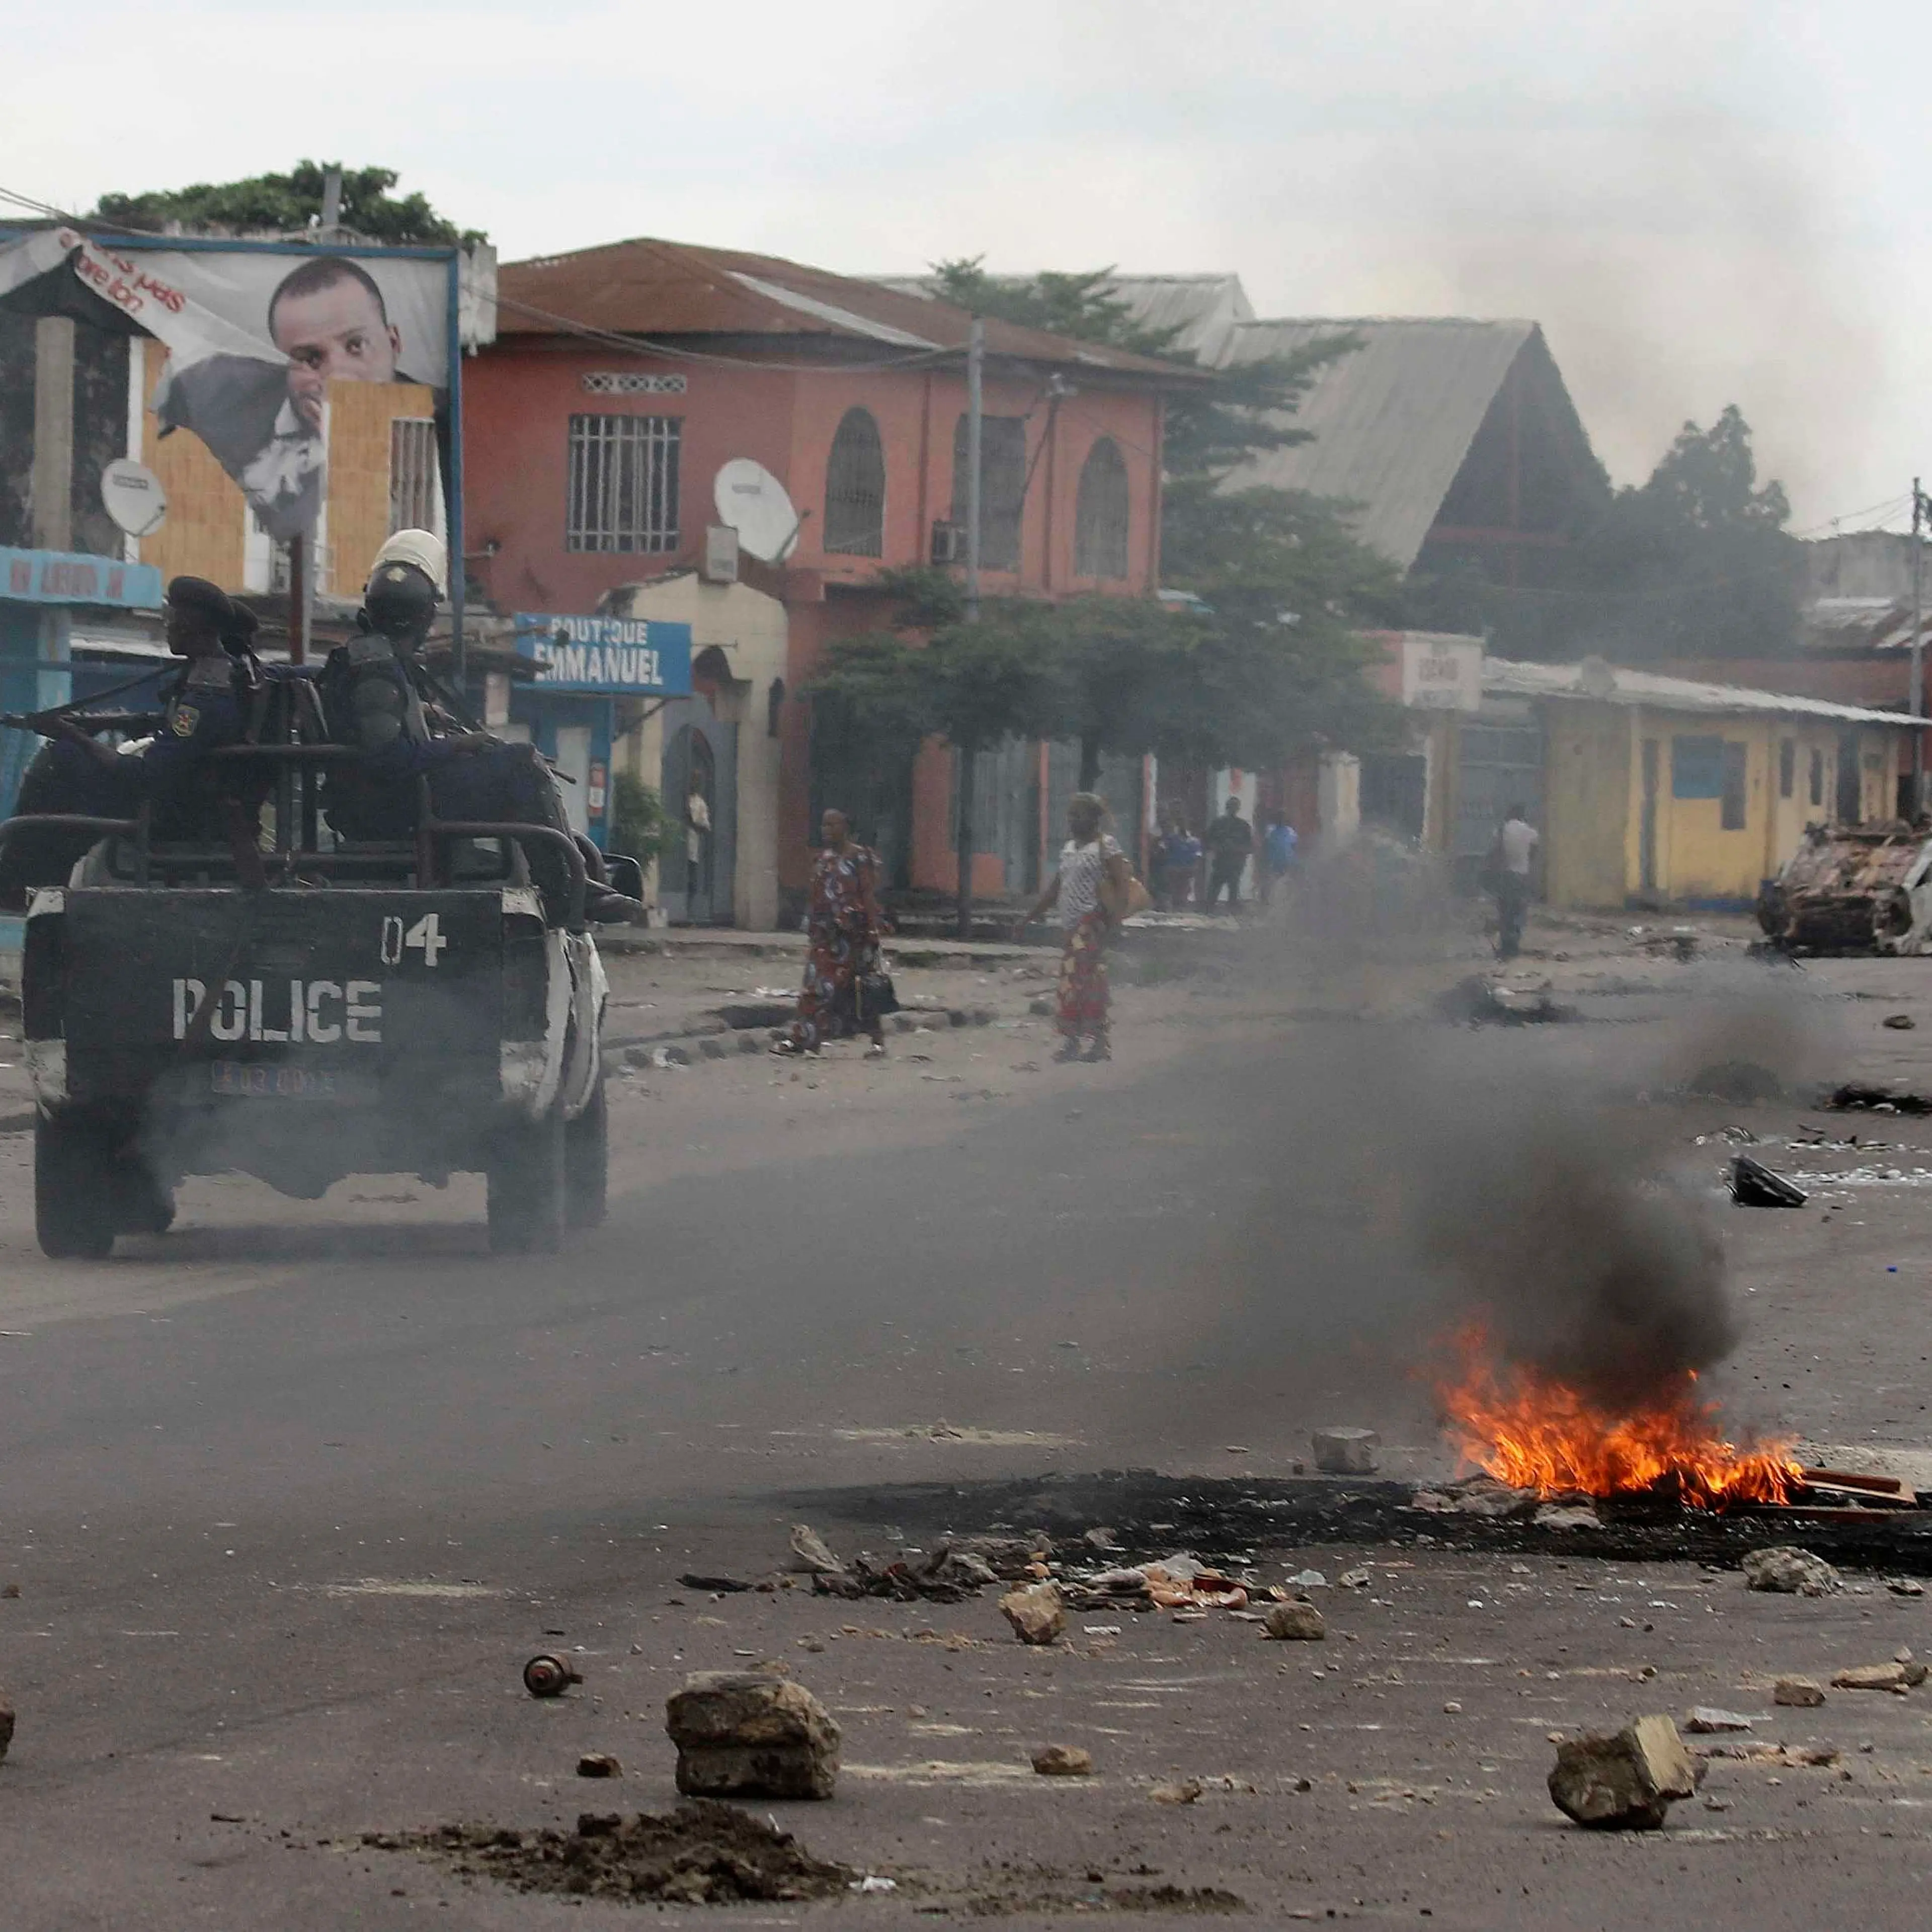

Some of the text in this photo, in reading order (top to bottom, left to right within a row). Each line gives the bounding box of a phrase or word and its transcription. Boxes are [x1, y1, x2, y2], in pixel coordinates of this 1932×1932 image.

[533, 642, 663, 685] EMMANUEL
[381, 913, 447, 967] 04
[173, 978, 382, 1043] POLICE
